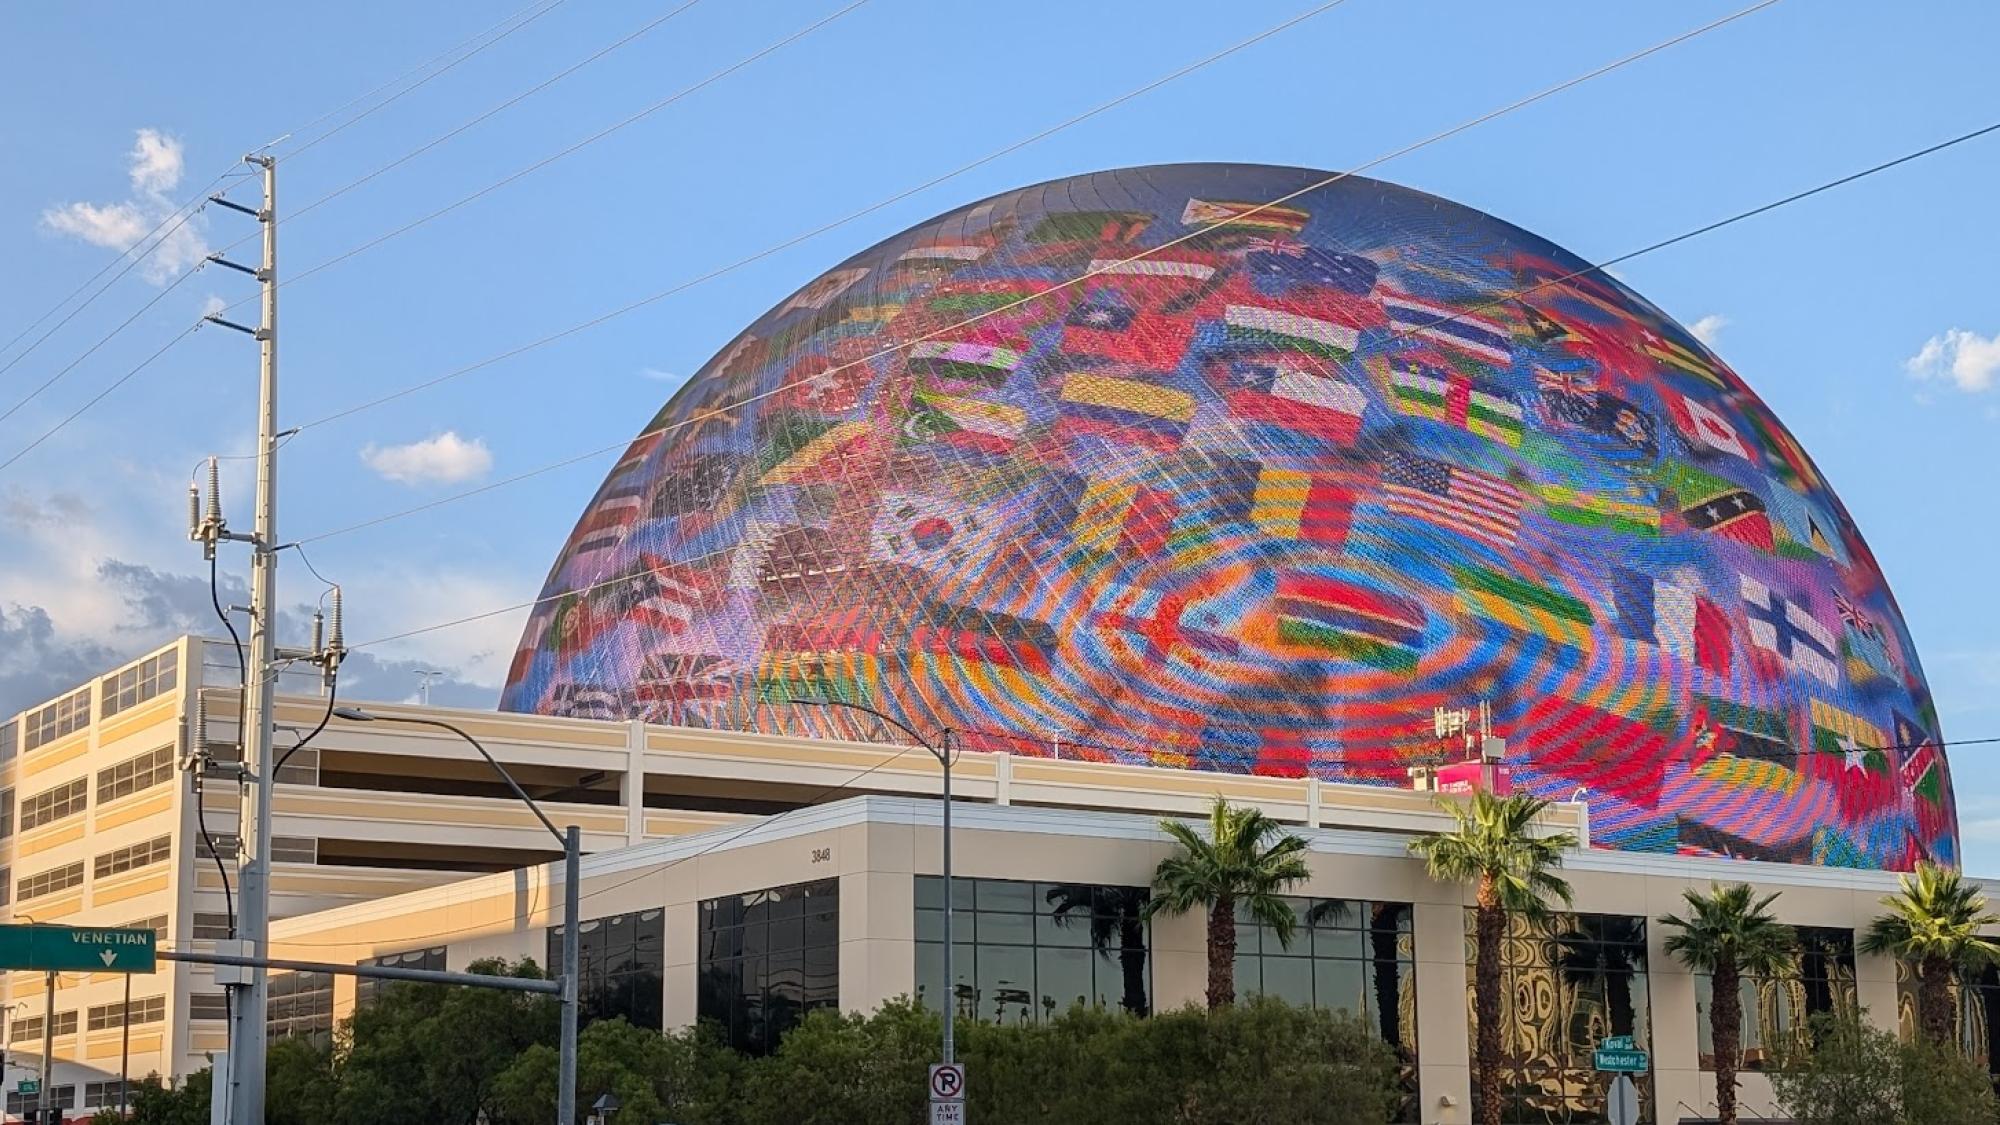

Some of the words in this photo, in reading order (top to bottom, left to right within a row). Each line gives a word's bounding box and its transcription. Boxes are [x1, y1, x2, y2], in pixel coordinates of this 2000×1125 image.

[811, 848, 830, 863] 3848
[72, 932, 147, 945] VENETIAN
[937, 1104, 958, 1113] ANY
[936, 1113, 960, 1122] TIME
